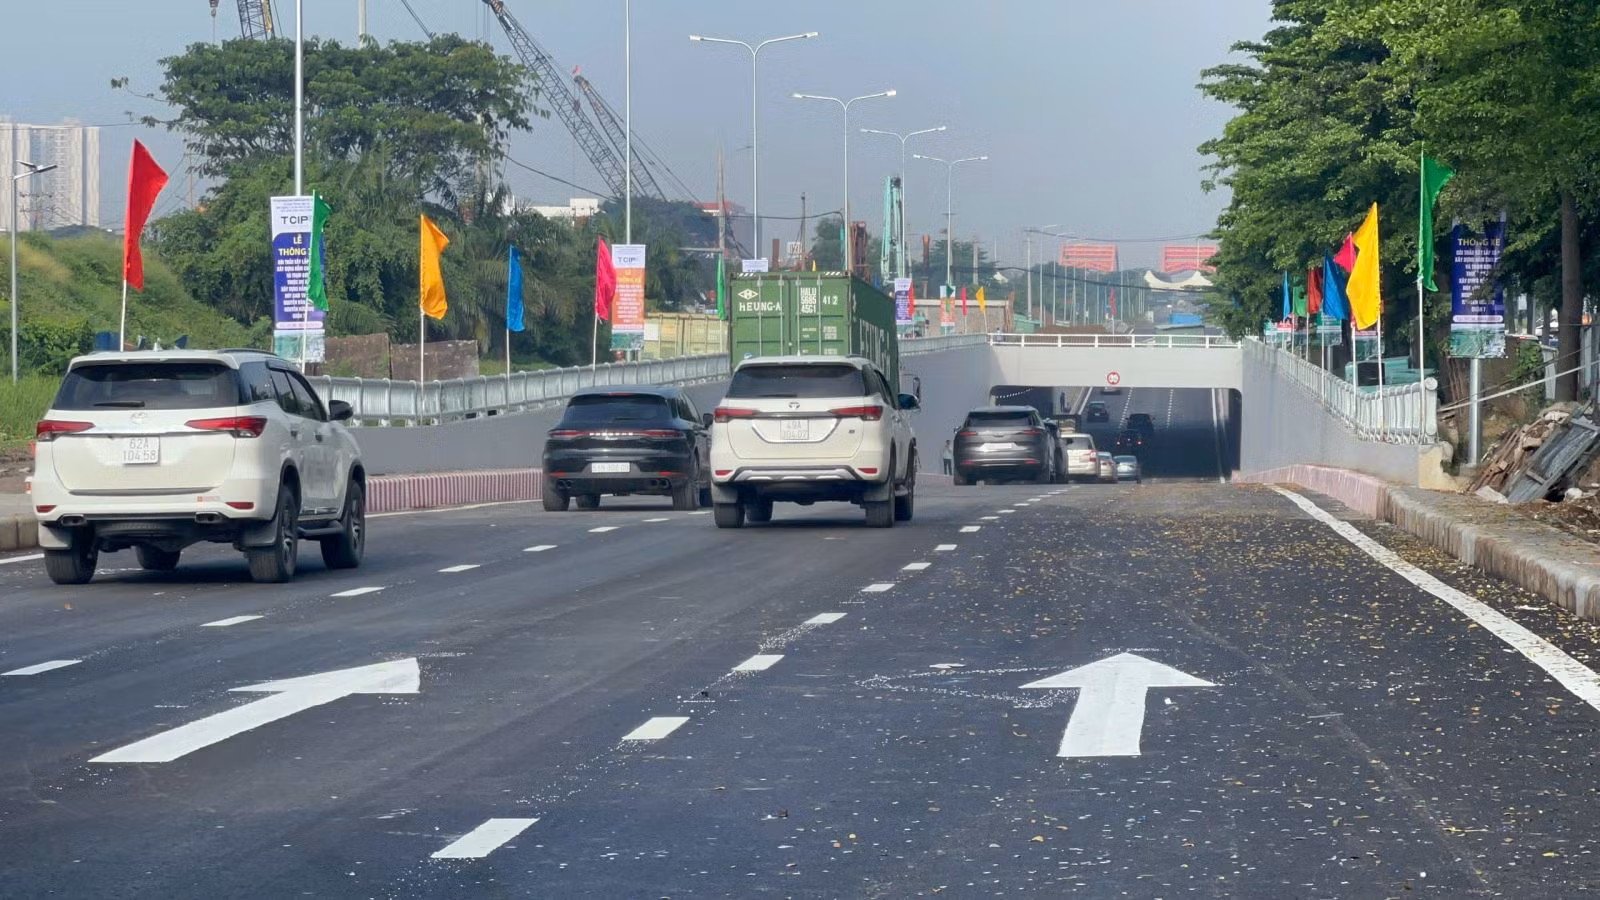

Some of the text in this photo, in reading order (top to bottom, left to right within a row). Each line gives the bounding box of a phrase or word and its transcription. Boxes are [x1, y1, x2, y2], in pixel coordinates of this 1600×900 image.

[281, 216, 308, 224] TCIP
[278, 247, 306, 256] THÔNG
[801, 288, 817, 296] HALU
[130, 438, 149, 449] 62A
